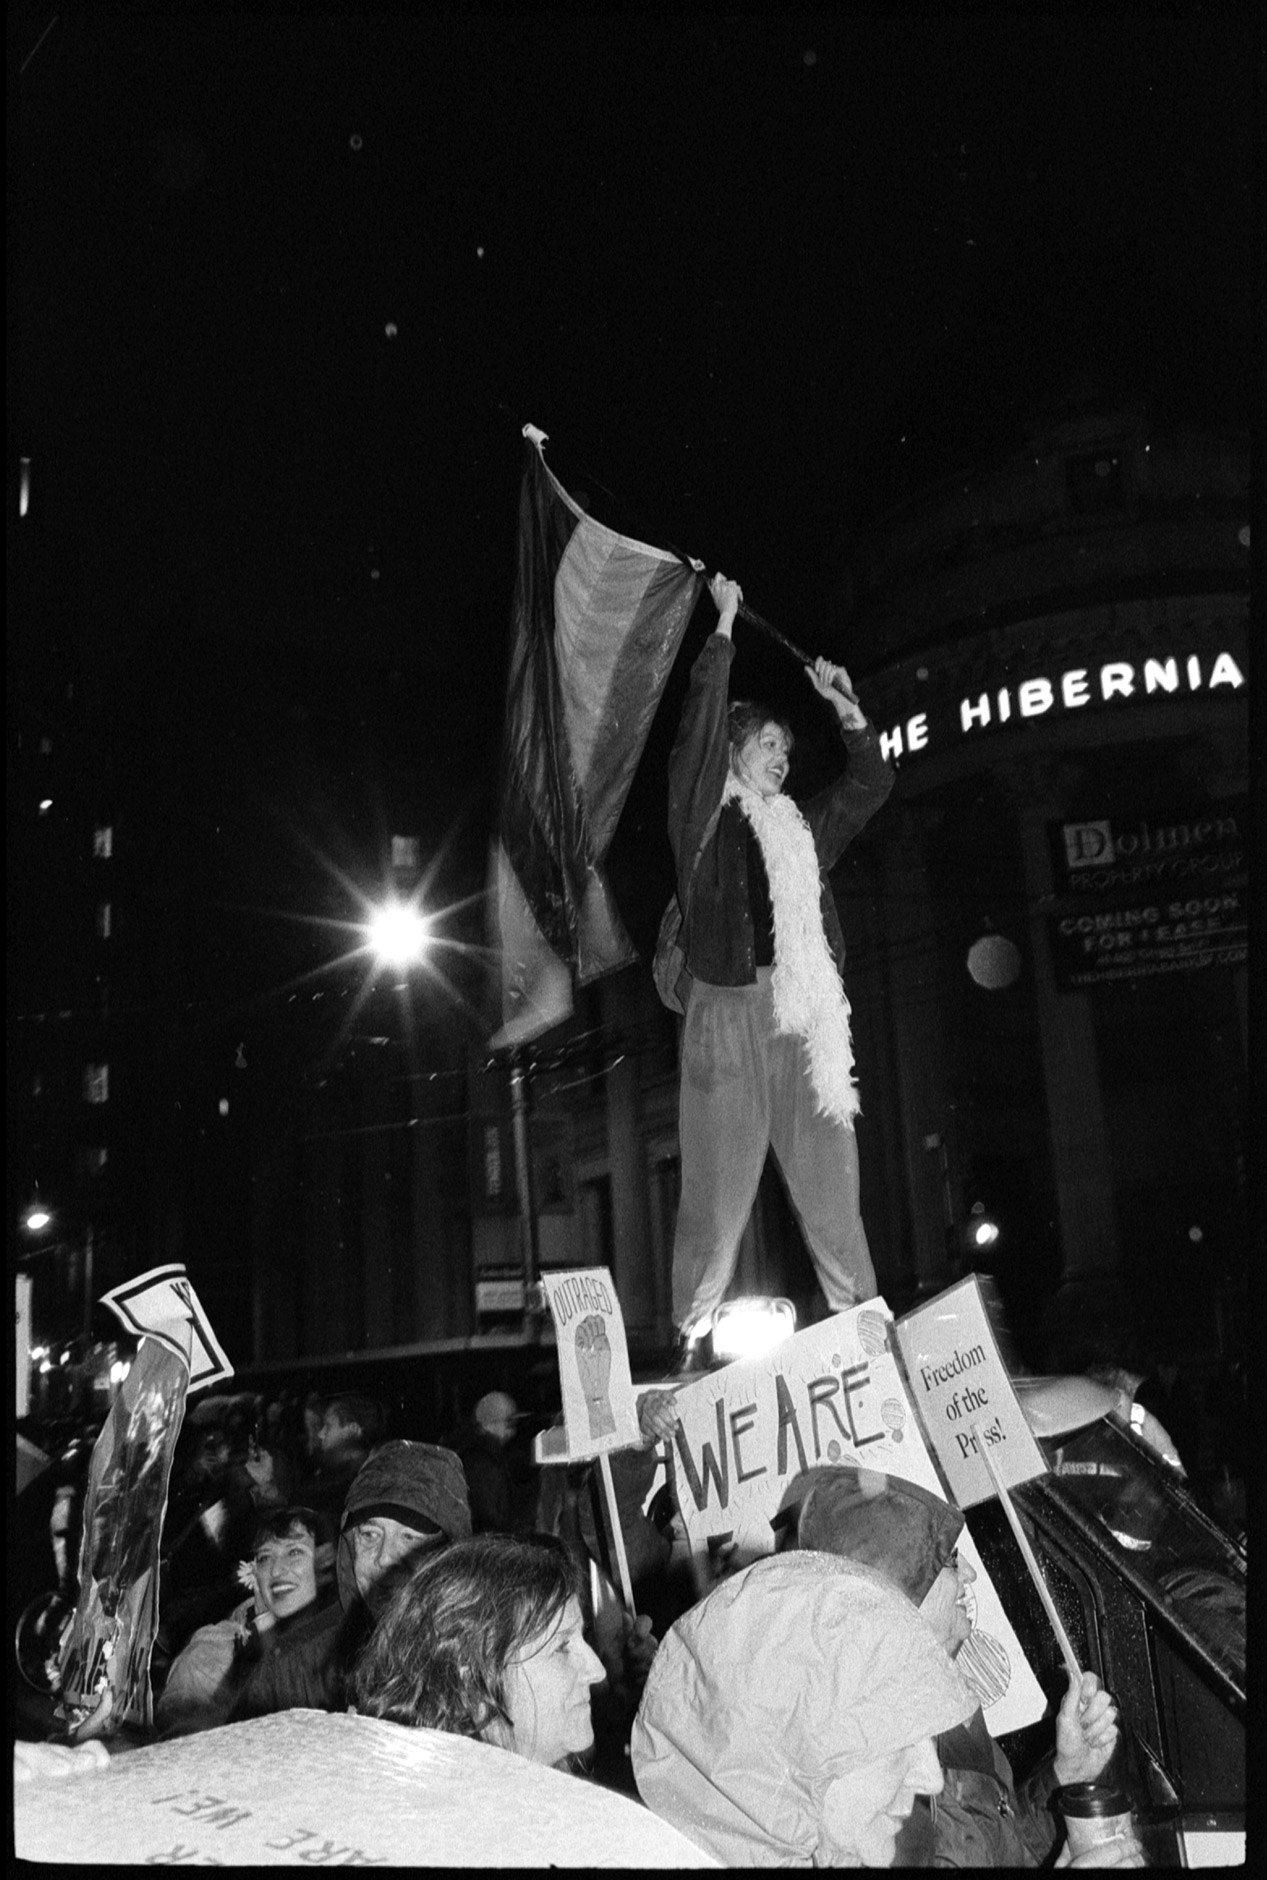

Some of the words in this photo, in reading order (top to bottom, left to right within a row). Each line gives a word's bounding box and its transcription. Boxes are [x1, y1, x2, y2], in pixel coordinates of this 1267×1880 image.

[878, 712, 929, 763] HE
[960, 651, 1245, 733] HIBERNIA
[1059, 906, 1160, 934] COMING
[1168, 892, 1240, 919] SOON
[1083, 931, 1133, 952] FOR
[552, 1275, 613, 1327] OUTRAGED
[920, 1344, 987, 1392] Freedom
[945, 1391, 963, 1421] of
[962, 1386, 989, 1414] the
[674, 1397, 768, 1513] WE
[775, 1360, 886, 1476] ARE
[955, 1416, 1007, 1459] Prss!
